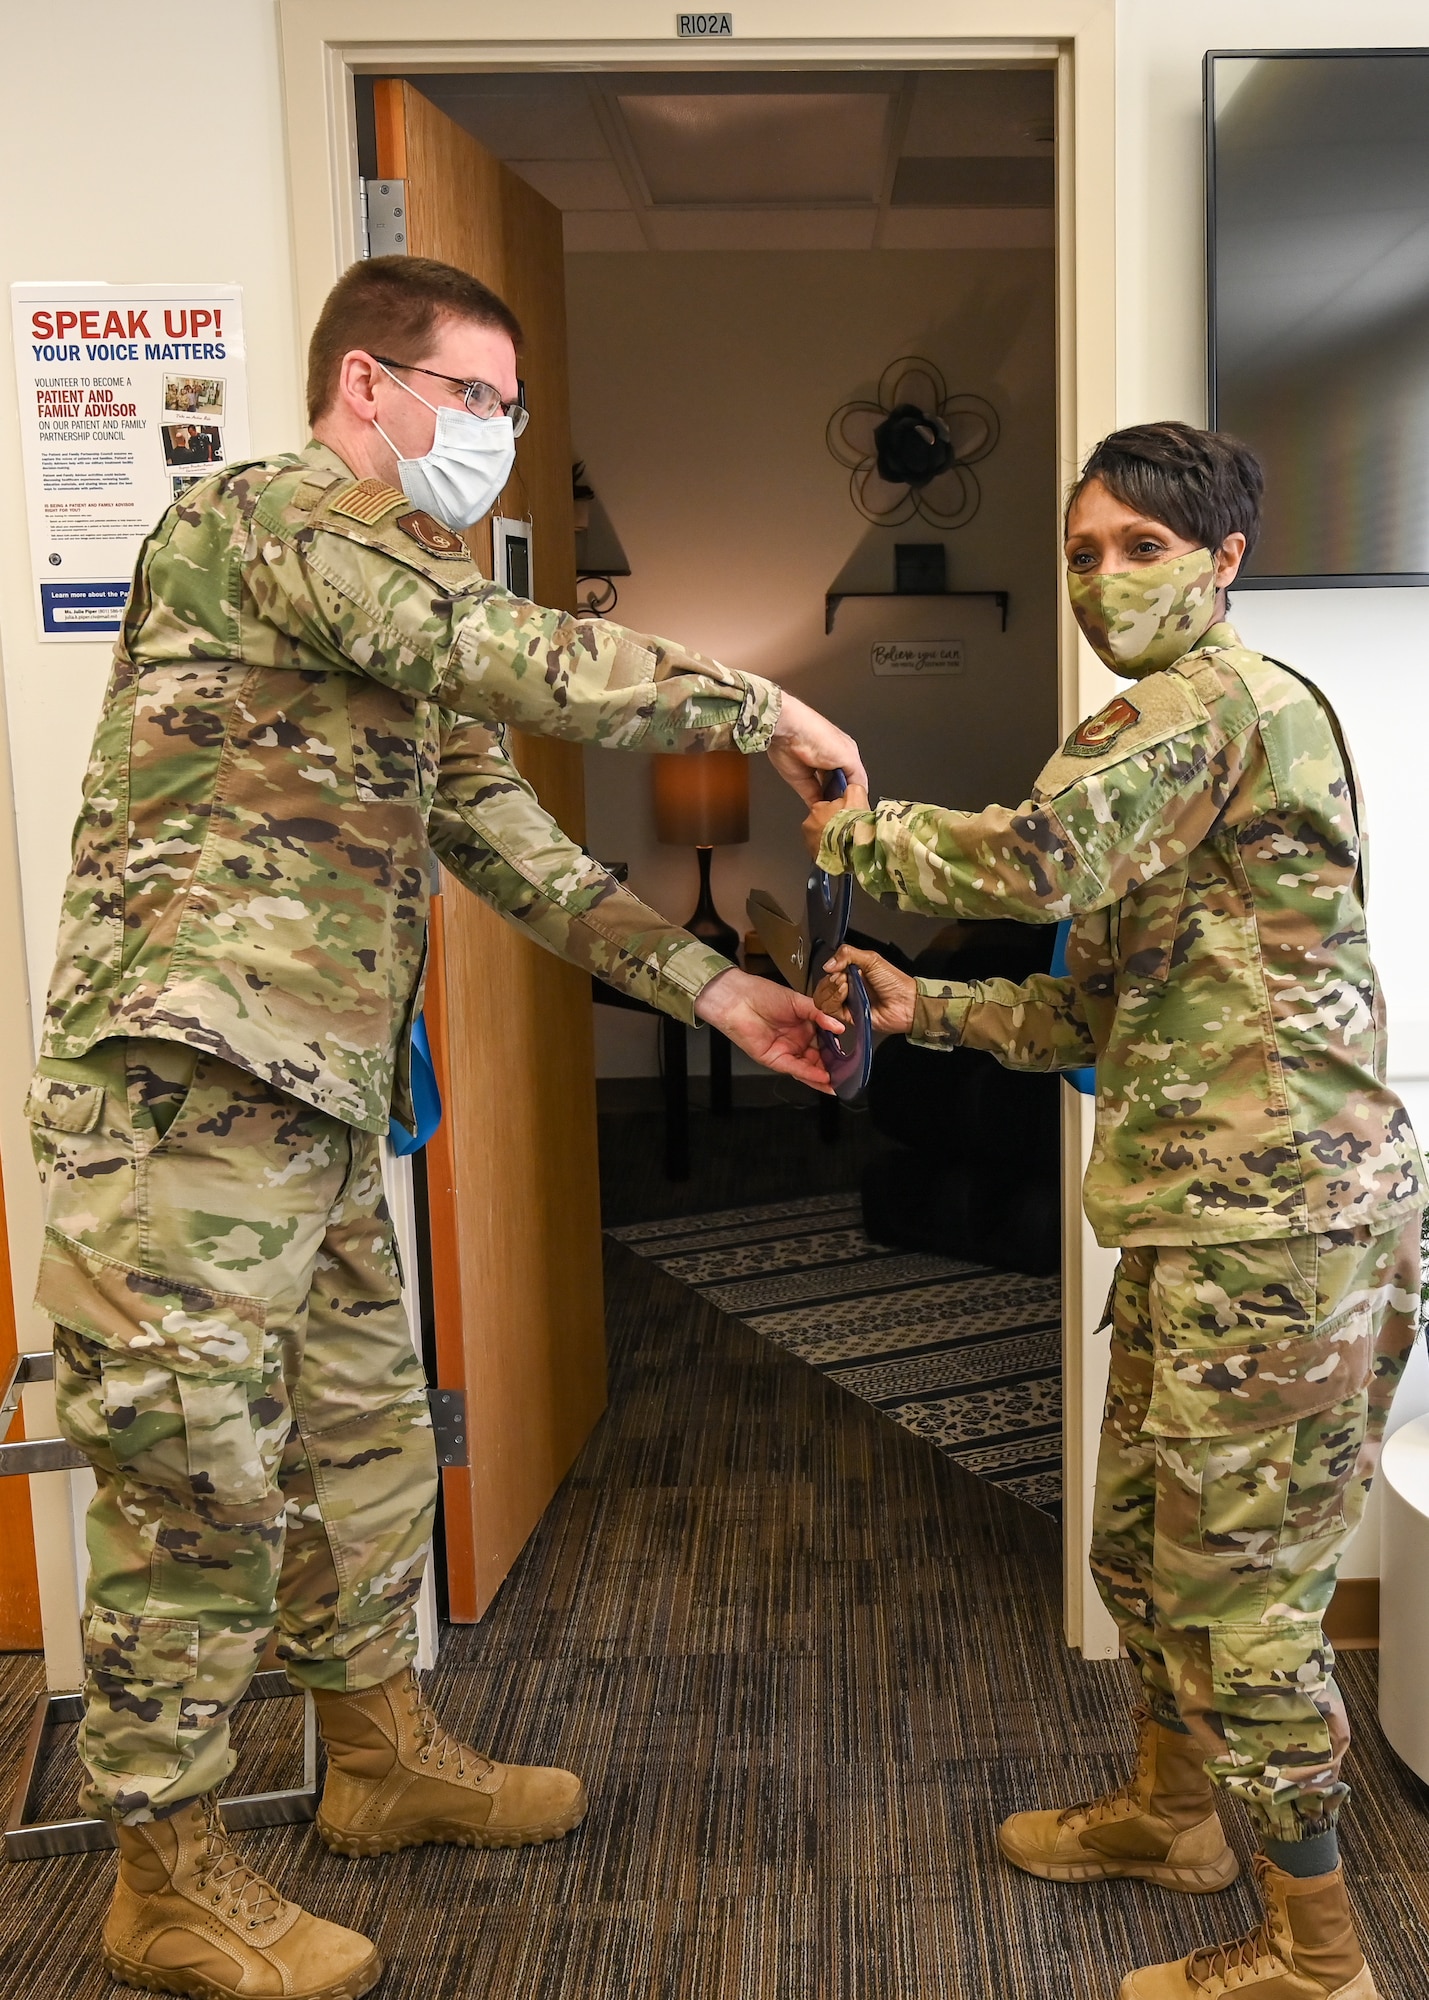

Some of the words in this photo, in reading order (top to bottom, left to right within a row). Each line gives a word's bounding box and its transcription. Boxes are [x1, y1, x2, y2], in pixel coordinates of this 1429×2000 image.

[31, 310, 151, 340] SPEAK
[164, 309, 222, 338] UP!
[32, 344, 81, 362] YOUR
[86, 344, 139, 361] VOICE
[145, 342, 226, 360] MATTERS
[35, 377, 78, 387] VOLUNTEER
[81, 378, 90, 387] TO
[93, 377, 124, 387] BECOME
[126, 378, 132, 386] A
[37, 390, 83, 404] PATIENT
[89, 390, 113, 403] AND
[38, 404, 79, 418] FAMILY
[84, 404, 136, 417] ADVISOR
[38, 420, 50, 430] ON
[53, 420, 69, 429] OUR
[71, 420, 100, 429] PATIENT
[102, 420, 118, 429] AND
[121, 420, 147, 429] FAMILY
[39, 432, 90, 441] PARTNERSHIP
[92, 432, 125, 441] COUNCIL
[873, 645, 915, 665] Believe
[915, 650, 936, 671] you
[940, 649, 961, 659] can
